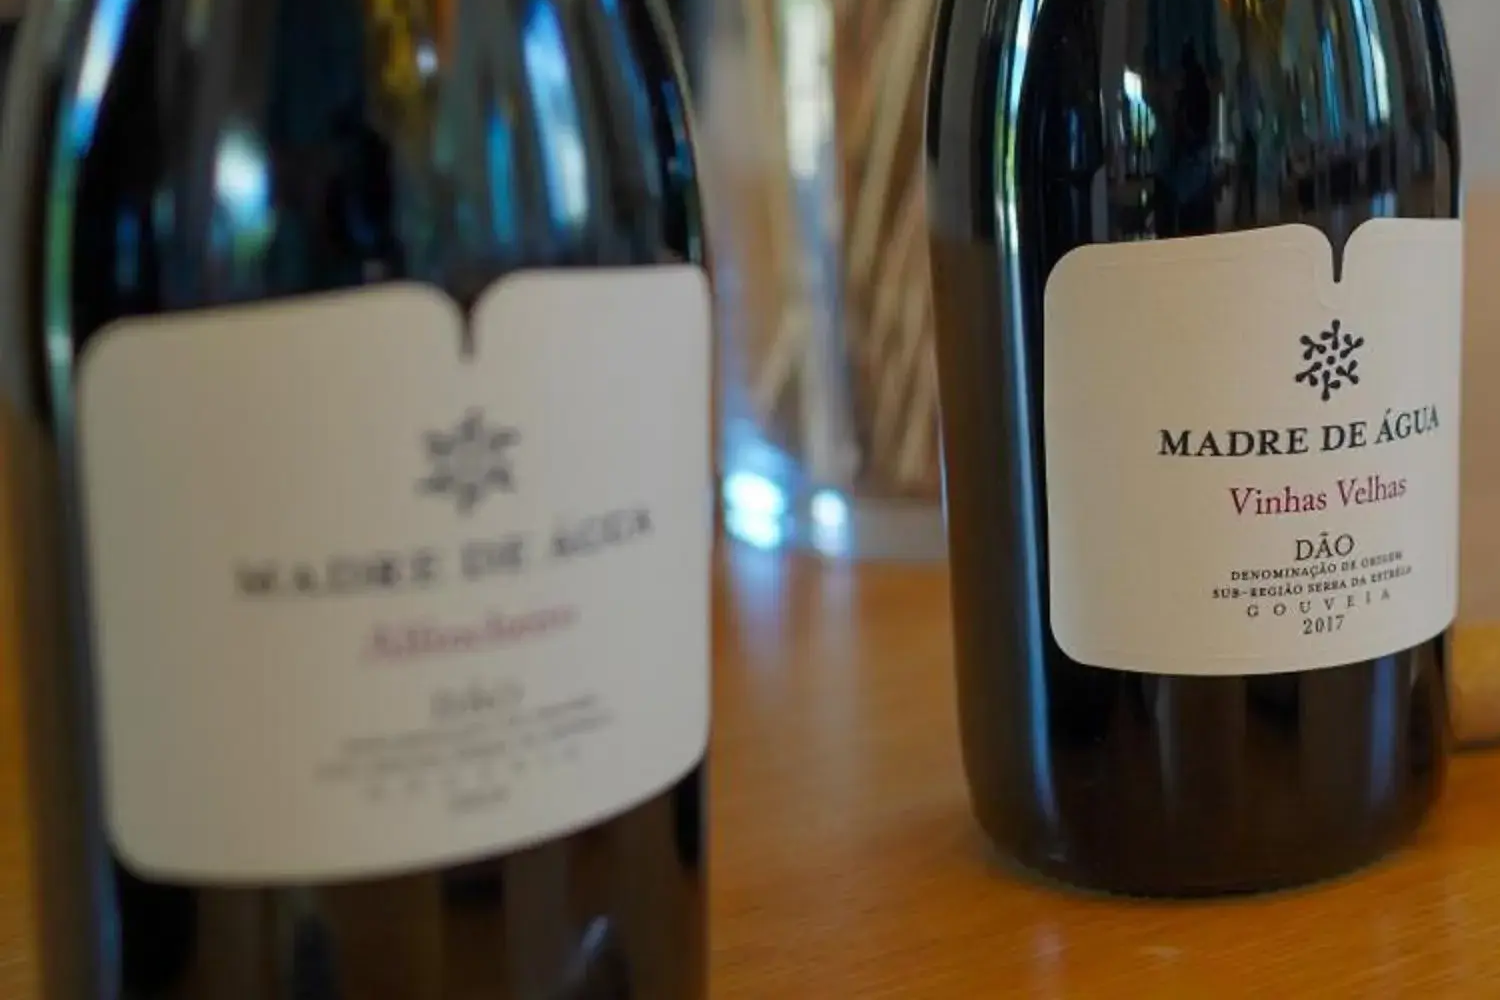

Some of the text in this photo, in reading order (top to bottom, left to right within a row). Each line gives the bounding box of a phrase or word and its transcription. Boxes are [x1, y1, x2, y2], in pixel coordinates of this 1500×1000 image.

[1158, 403, 1440, 457] MADRE DE ÁGUA
[1229, 472, 1408, 516] Vinhas Velhas
[1294, 532, 1355, 561] DÃO
[1230, 562, 1338, 582] DENOMINAÇÃO
[1350, 574, 1368, 588] DA
[1303, 614, 1346, 636] 2017
